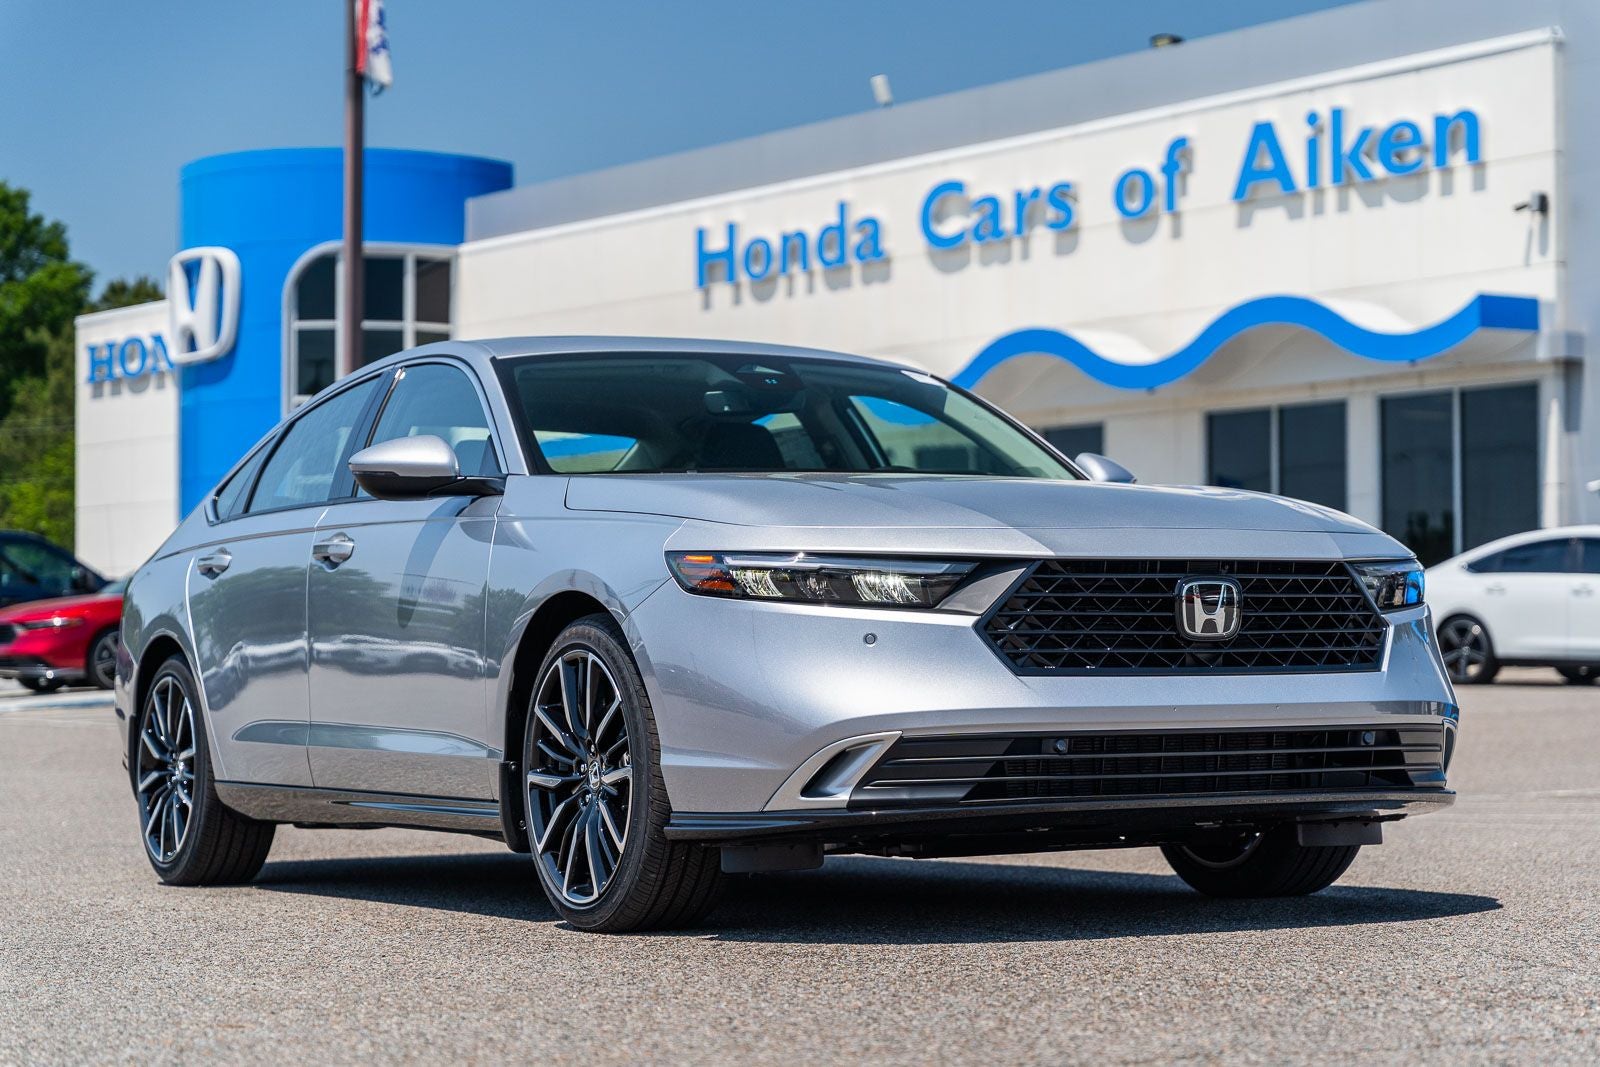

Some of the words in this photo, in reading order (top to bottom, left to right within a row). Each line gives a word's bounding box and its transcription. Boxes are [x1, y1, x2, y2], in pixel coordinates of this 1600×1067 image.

[695, 200, 886, 289] Honda
[918, 178, 1076, 251] Cars
[1112, 135, 1189, 220] of
[1231, 106, 1481, 202] Aiken
